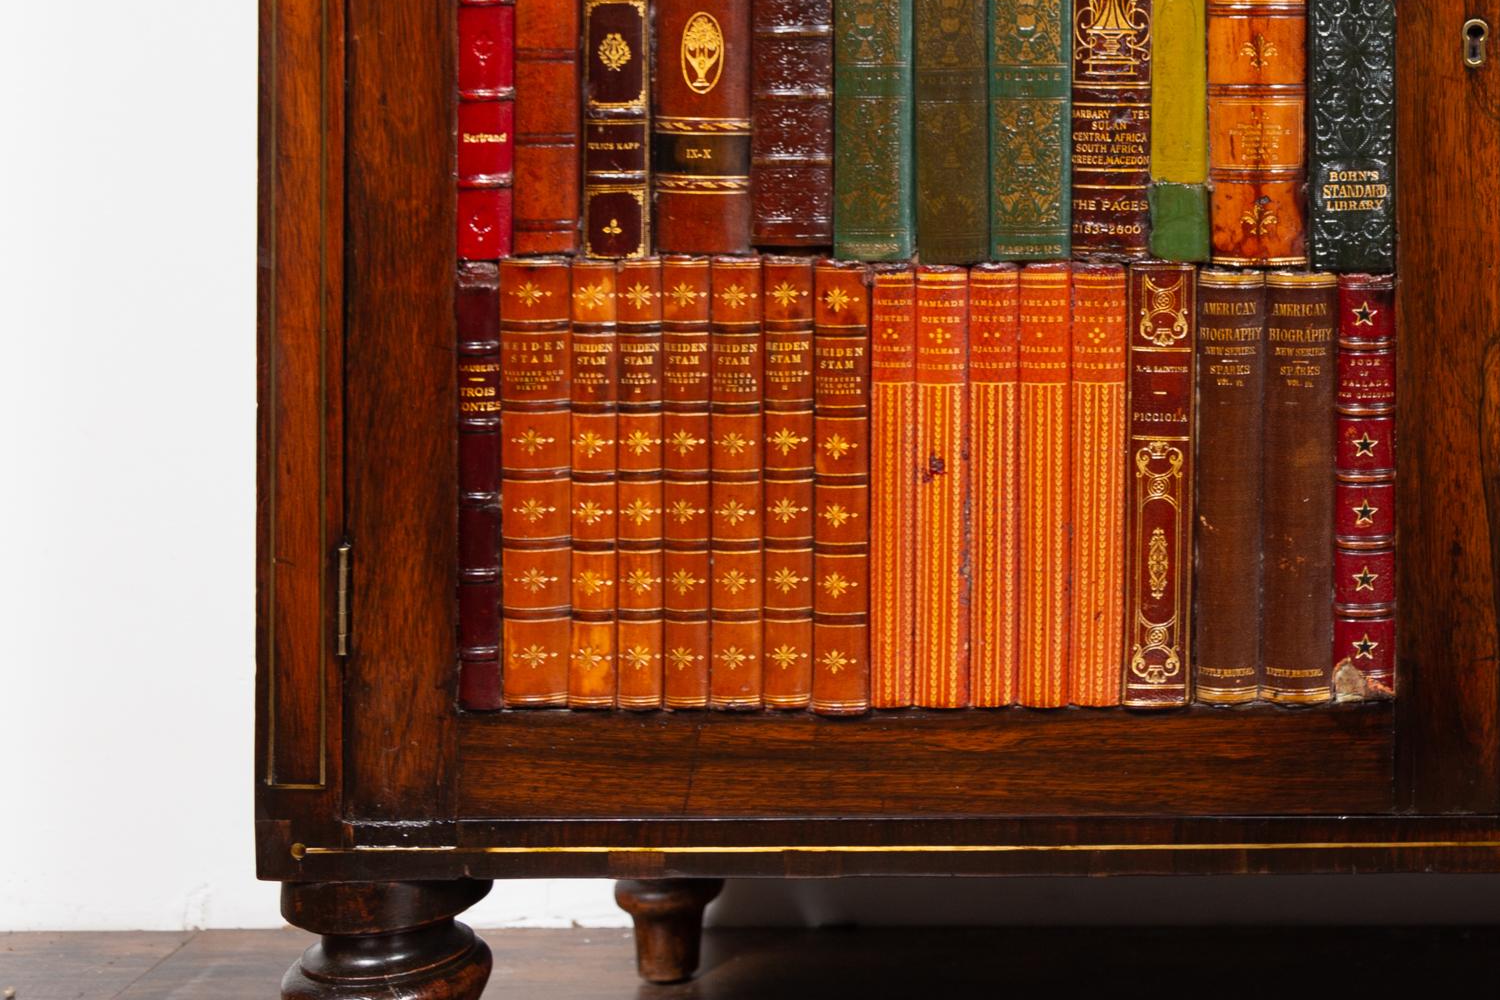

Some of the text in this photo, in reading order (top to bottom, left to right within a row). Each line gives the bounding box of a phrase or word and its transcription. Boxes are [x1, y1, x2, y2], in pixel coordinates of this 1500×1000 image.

[463, 133, 507, 144] Bertrand
[1073, 132, 1147, 143] CENTRAL AFRICA
[1076, 144, 1144, 154] SOUTH AFRICA
[1329, 170, 1380, 182] BOHN'S
[1322, 184, 1388, 199] STANDARD
[1101, 200, 1149, 211] PAGES
[1326, 199, 1385, 212] LIBRARY
[1203, 302, 1257, 316] AMERICAN
[1272, 303, 1327, 316] AMERICAN
[922, 316, 961, 324] DIKTER
[1200, 327, 1263, 341] BIOGRAPHY
[1269, 328, 1333, 341] BIOGRAPHY
[573, 343, 613, 353] HEIDEN
[620, 343, 660, 353] HEIDEN
[1205, 346, 1225, 355] NEW
[577, 357, 607, 366] STAM
[624, 357, 654, 366] STAM
[669, 356, 700, 365] STAM
[770, 355, 802, 364] STAM
[1209, 365, 1251, 375] SPARKS
[1280, 366, 1321, 376] SPARKS
[461, 387, 496, 397] TROIS
